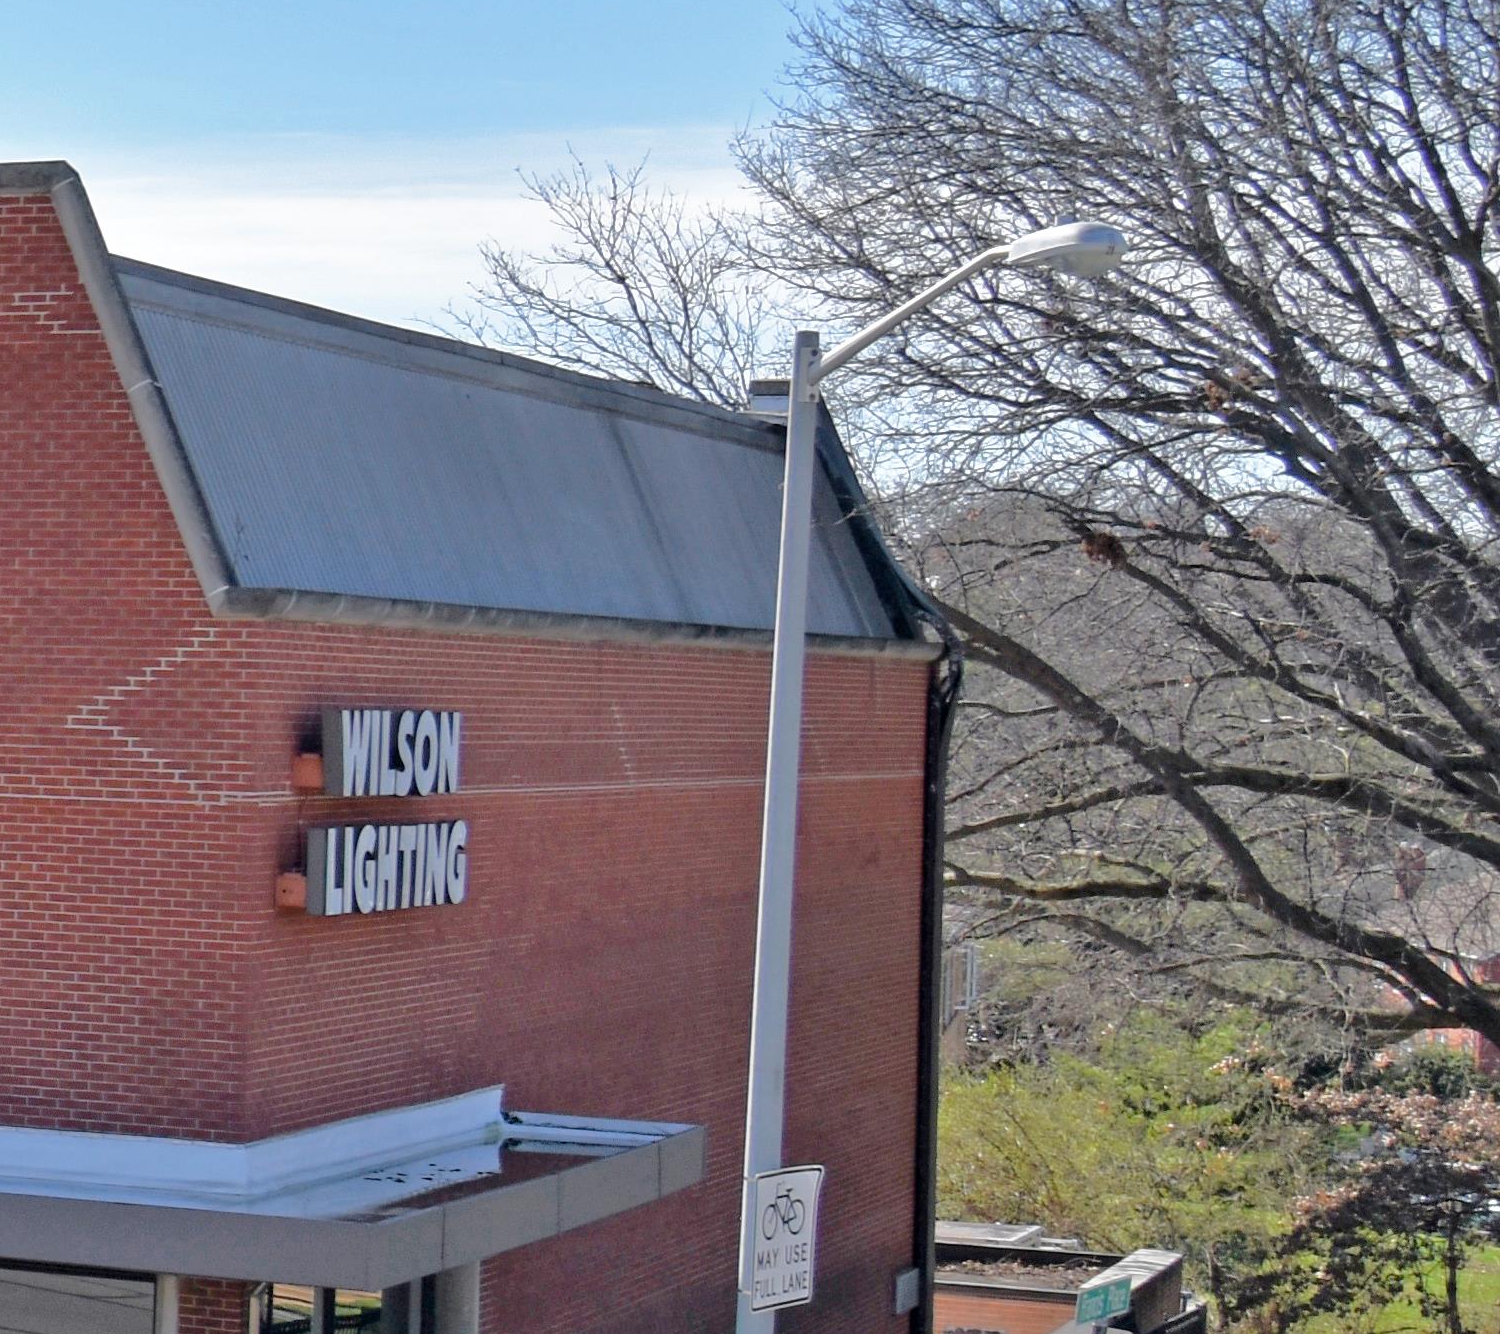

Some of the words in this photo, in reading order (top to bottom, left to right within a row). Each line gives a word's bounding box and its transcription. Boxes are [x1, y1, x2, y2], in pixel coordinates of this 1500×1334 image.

[340, 708, 463, 798] WILSON
[324, 819, 470, 917] LIGHTING
[754, 1276, 778, 1300] FULL
[781, 1269, 808, 1295] LANE
[756, 1247, 780, 1271] MAY
[785, 1242, 808, 1265] USE
